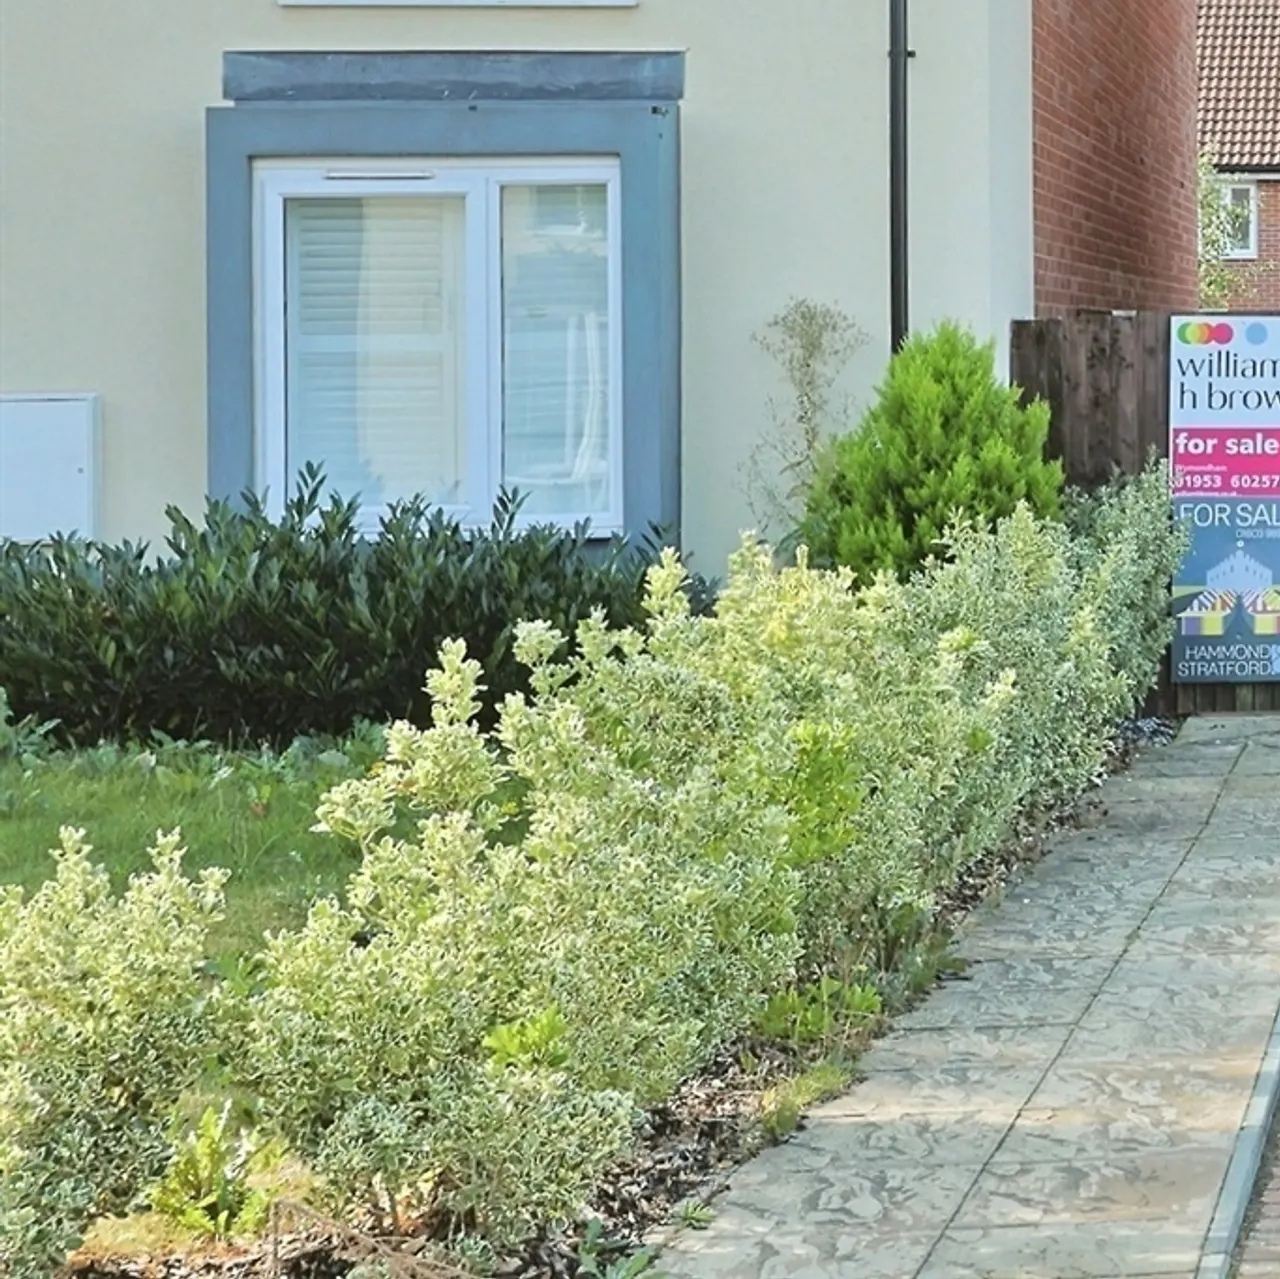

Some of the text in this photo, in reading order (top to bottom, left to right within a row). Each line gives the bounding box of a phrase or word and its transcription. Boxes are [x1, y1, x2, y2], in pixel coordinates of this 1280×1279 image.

[1180, 382, 1197, 409] h
[1176, 432, 1280, 454] for sale
[1180, 503, 1231, 527] FOR
[1185, 644, 1271, 660] HAMMOND
[1178, 661, 1271, 677] STRATFORD
